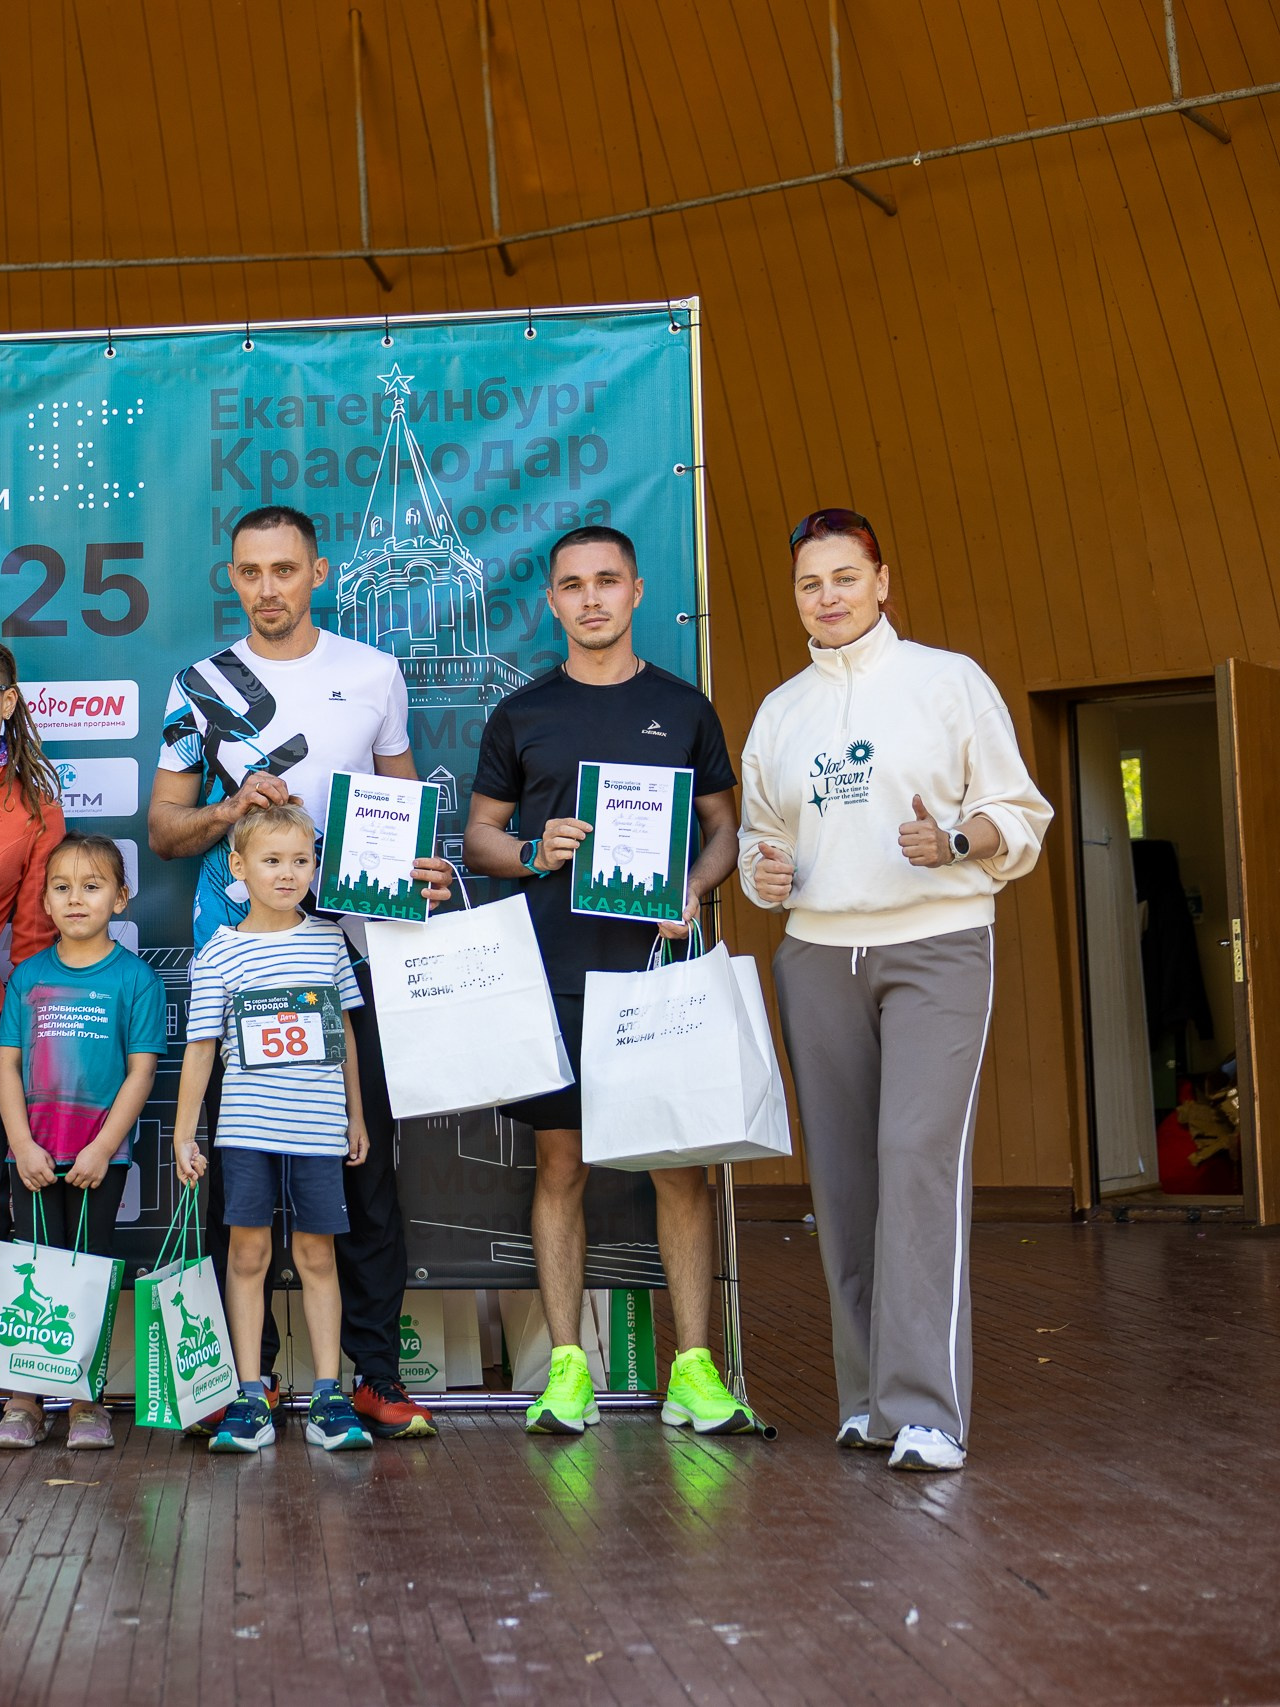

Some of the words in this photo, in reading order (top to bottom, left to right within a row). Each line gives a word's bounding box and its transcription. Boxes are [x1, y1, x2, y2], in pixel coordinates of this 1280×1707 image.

[211, 377, 608, 436] Екатеринбург
[211, 432, 609, 504] Краснодар
[410, 499, 613, 537] Москва
[83, 720, 126, 729] программа
[641, 729, 668, 737] DEMIX
[354, 789, 361, 798] 5
[360, 793, 390, 802] городов
[604, 779, 611, 789] 5
[610, 784, 641, 792] городов
[851, 791, 869, 800] simple
[355, 806, 410, 822] ДИПЛОМ
[606, 798, 663, 812] ДИПЛОМ
[323, 895, 422, 921] КАЗАНЬ
[578, 895, 679, 920] КАЗАНЬ
[243, 1000, 253, 1012] 5
[252, 1002, 290, 1012] городов
[261, 1026, 309, 1058] 58
[175, 1339, 221, 1374] bionova
[13, 1357, 35, 1370] ДНЯ
[36, 1360, 79, 1378] ОСНОВА
[147, 1321, 161, 1423] ПОДПИШИСЬ
[399, 1367, 431, 1377] СНОВА
[195, 1380, 208, 1397] ДНЯ
[207, 1369, 230, 1389] ОСНОВА
